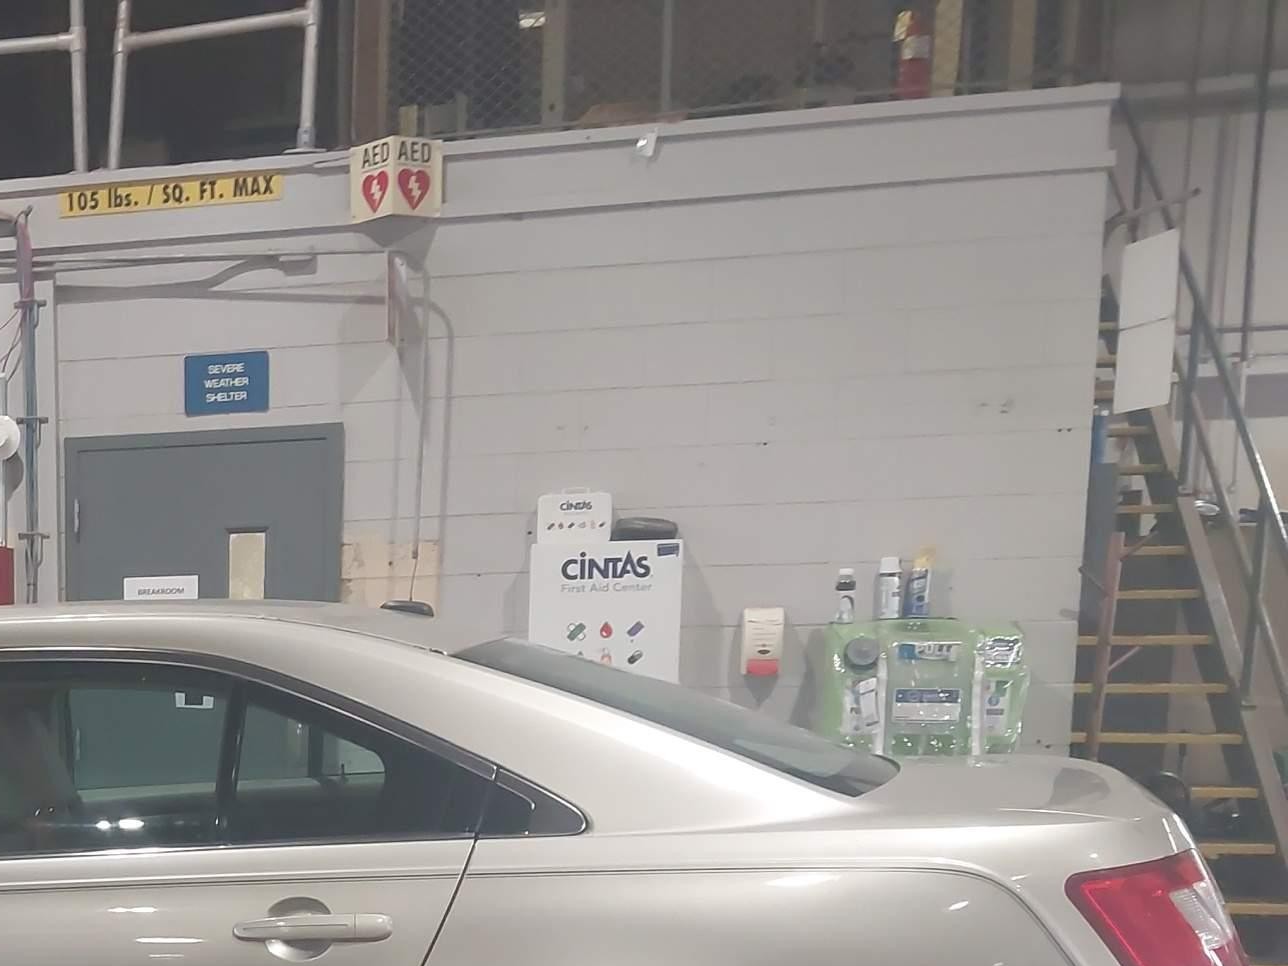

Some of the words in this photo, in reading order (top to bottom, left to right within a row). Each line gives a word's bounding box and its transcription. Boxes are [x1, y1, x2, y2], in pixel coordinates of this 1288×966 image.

[361, 141, 390, 169] AED
[397, 140, 432, 163] AED
[66, 190, 99, 212] 105
[107, 187, 139, 208] lbs.
[146, 184, 154, 206] /
[162, 182, 190, 205] SQ.
[199, 180, 224, 200] FT.
[232, 175, 274, 198] MAX
[208, 363, 245, 374] SEVERE
[204, 377, 249, 388] WEATHER
[206, 391, 247, 403] SHELTER
[138, 587, 185, 596] BREAKROOM
[561, 584, 586, 593] First
[590, 583, 609, 592] Aid
[612, 582, 652, 592] Center
